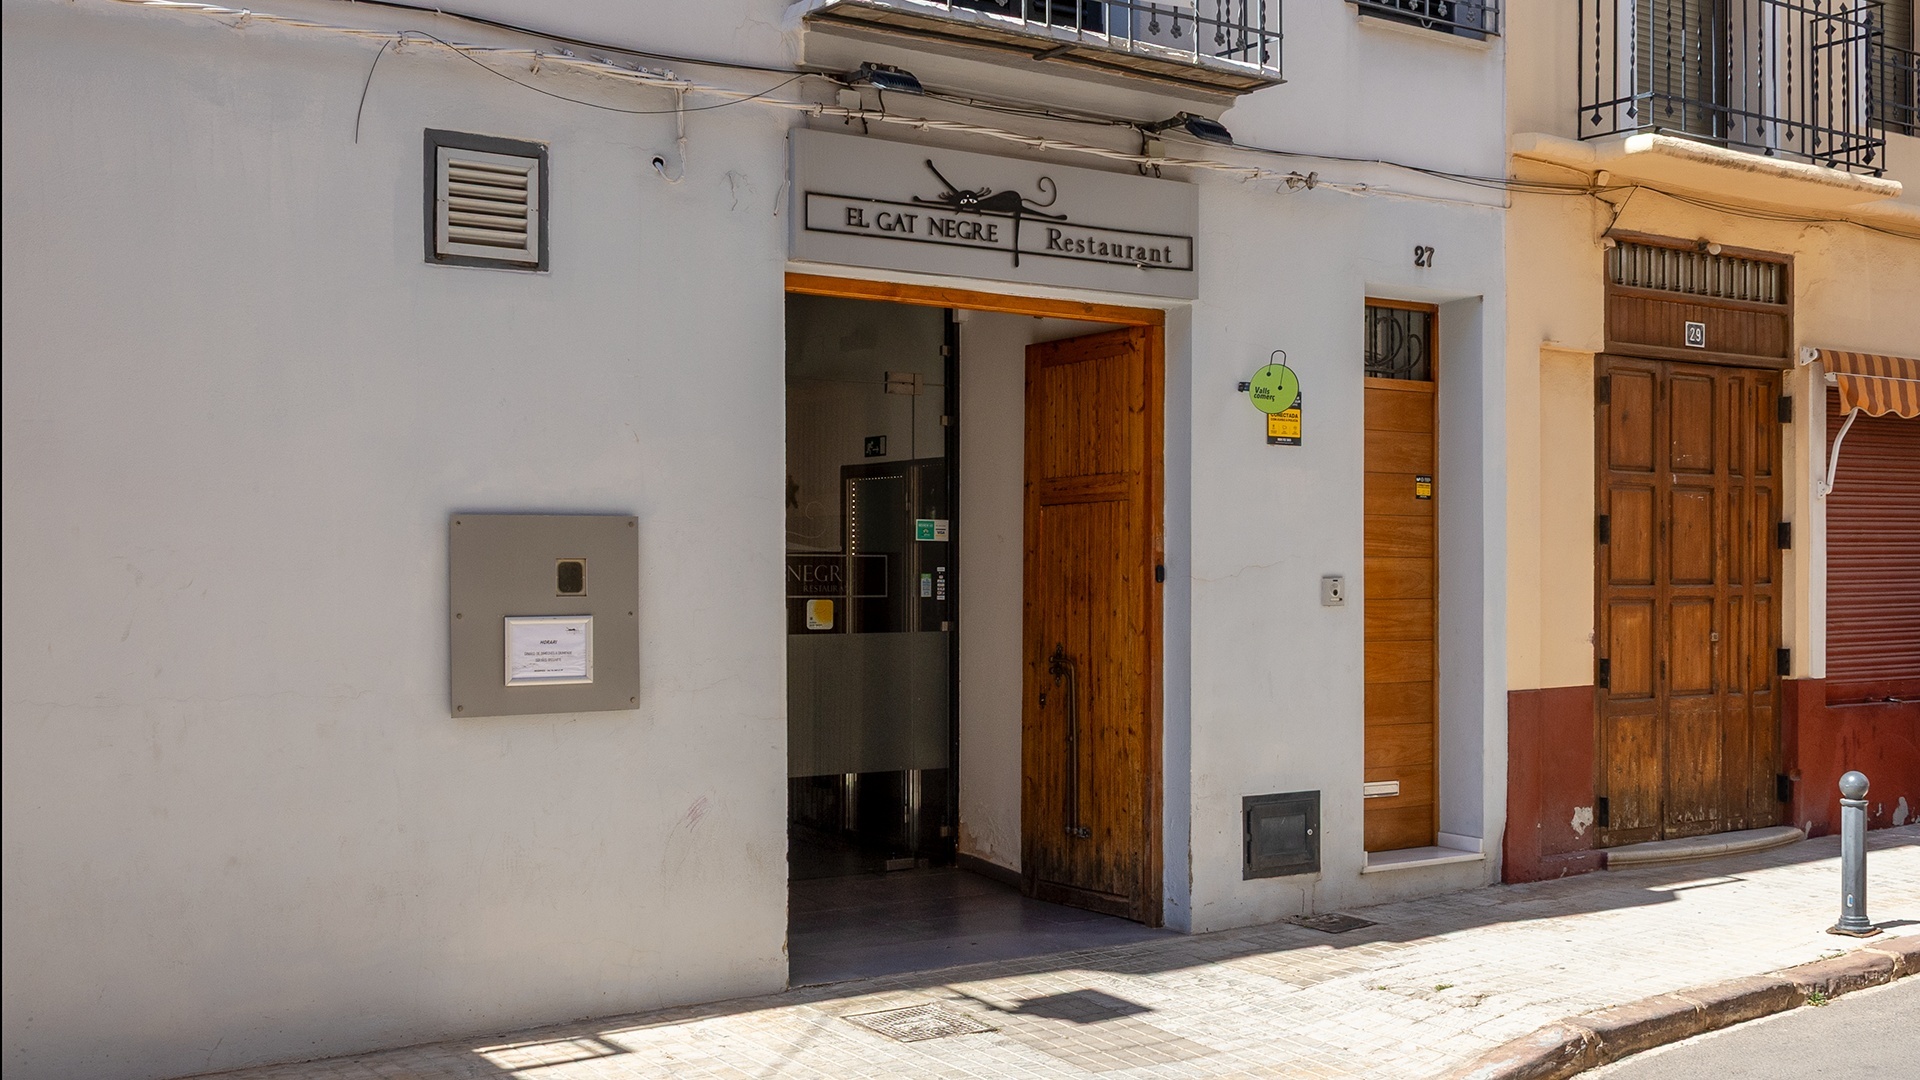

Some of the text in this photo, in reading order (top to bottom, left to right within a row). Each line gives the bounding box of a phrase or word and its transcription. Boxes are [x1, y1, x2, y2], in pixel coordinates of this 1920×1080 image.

[845, 206, 999, 243] EL GAT NEGRE
[1045, 227, 1172, 264] Restaurant
[1414, 245, 1435, 267] 27
[1689, 327, 1701, 342] 29
[1254, 386, 1270, 395] Valls
[787, 564, 842, 582] NEGR
